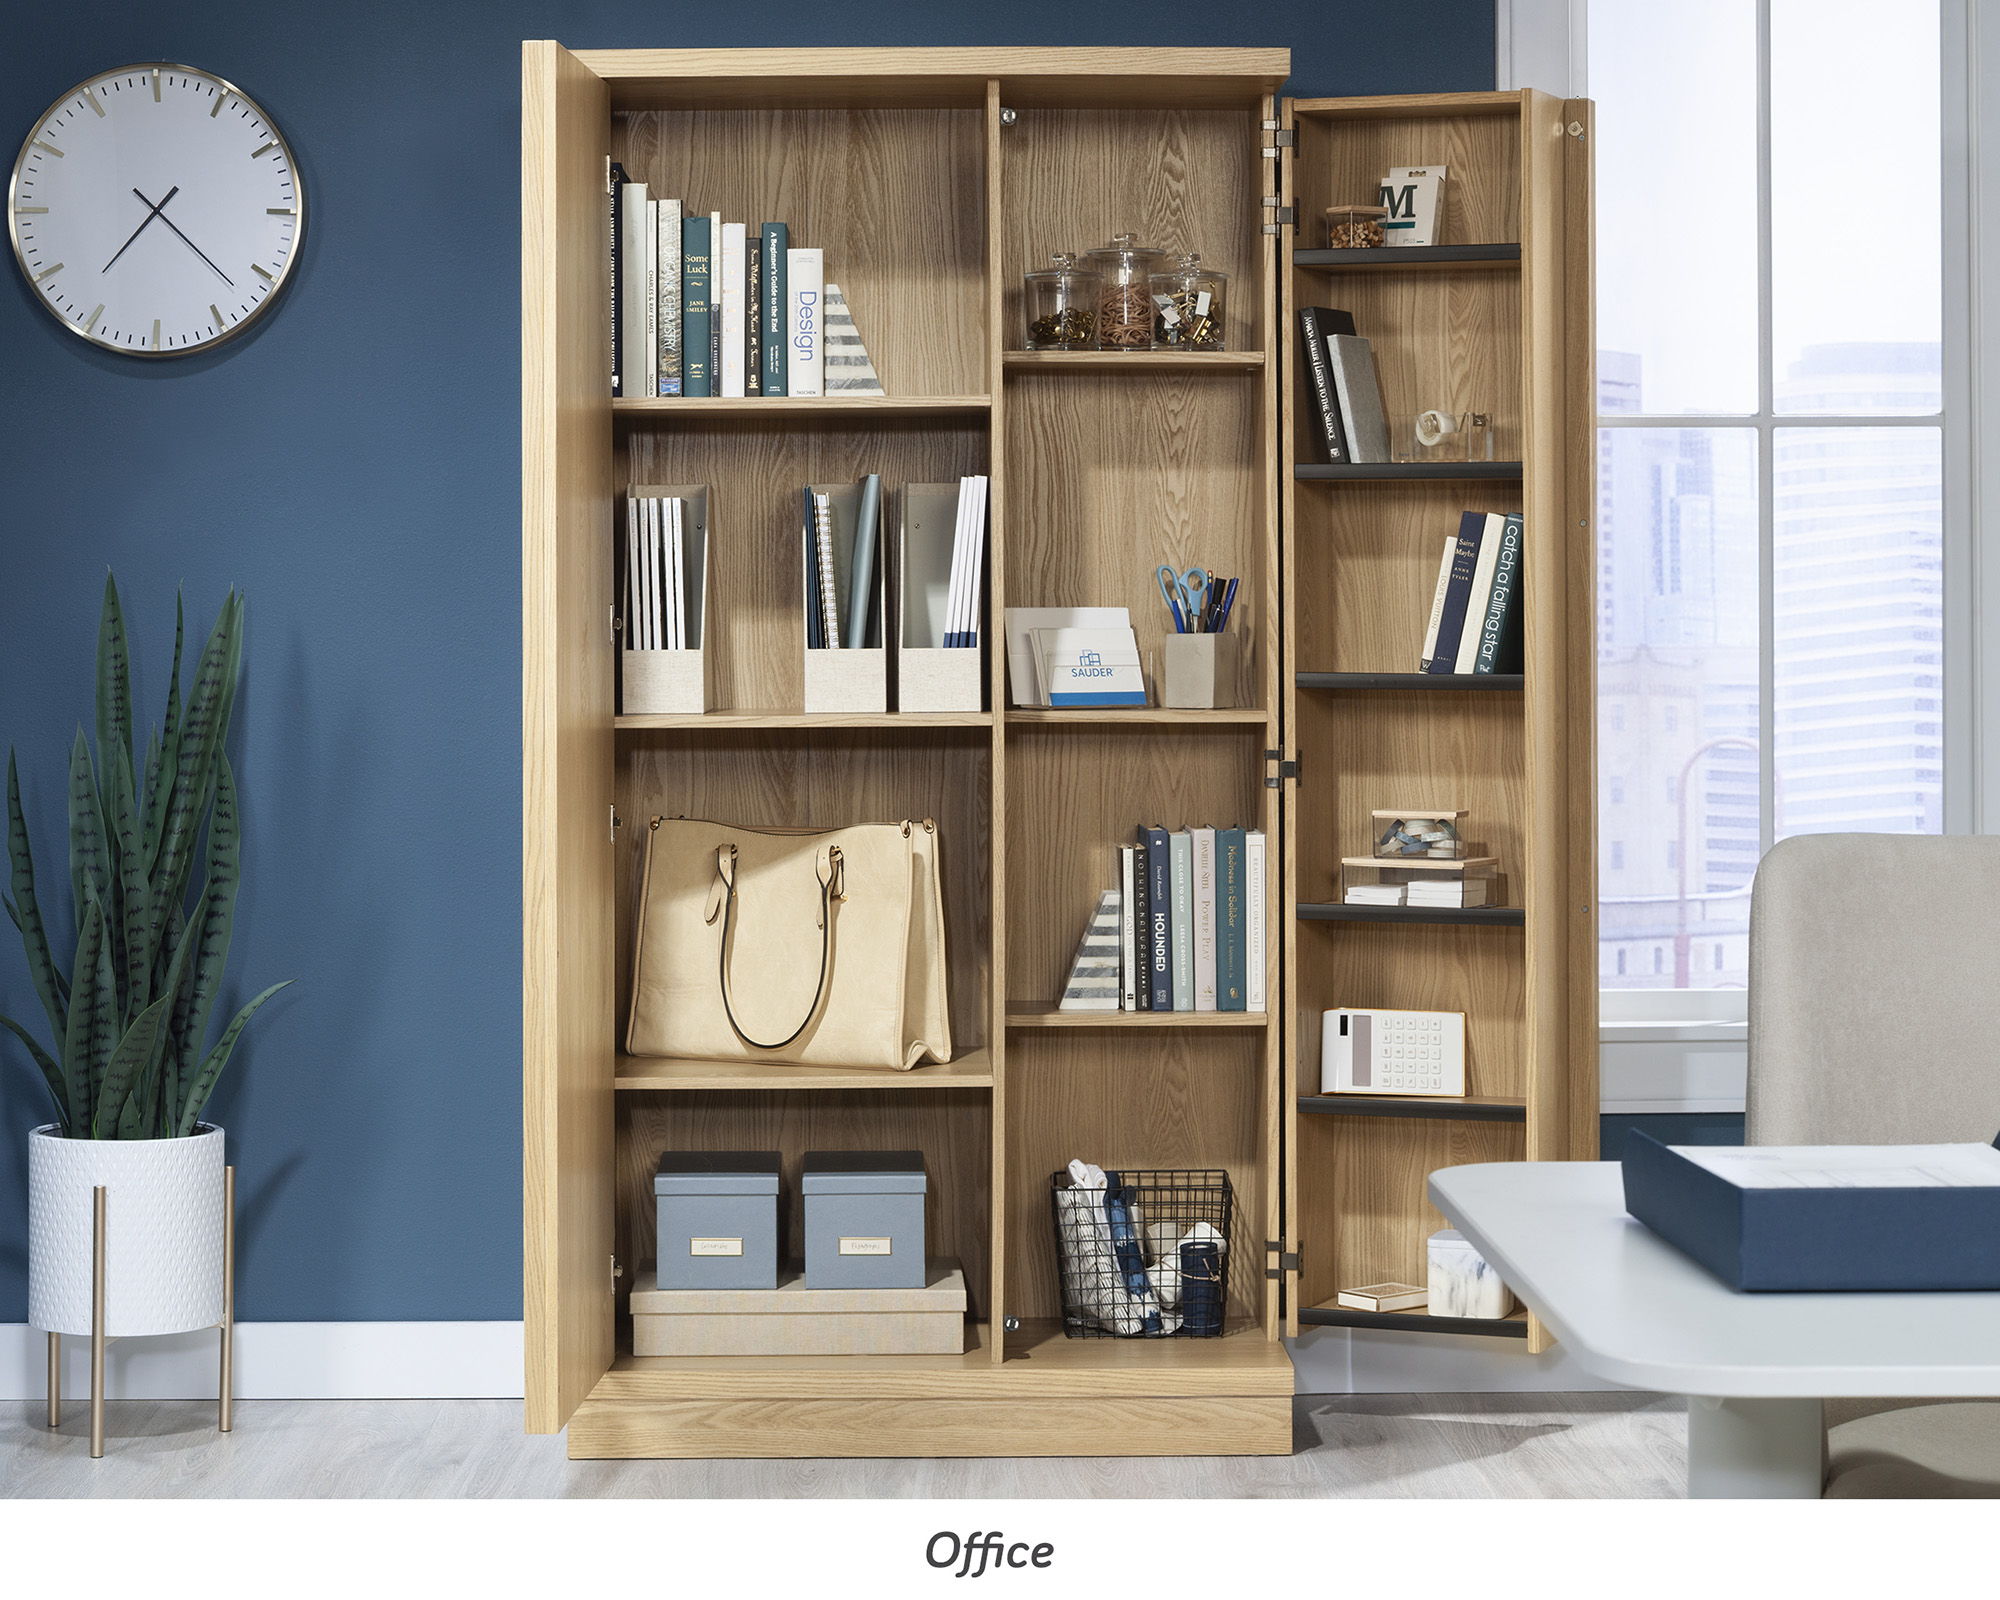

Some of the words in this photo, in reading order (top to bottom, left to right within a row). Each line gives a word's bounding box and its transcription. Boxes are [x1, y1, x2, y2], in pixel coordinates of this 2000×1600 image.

[685, 254, 709, 263] Some
[686, 263, 708, 274] Luck
[769, 238, 778, 275] Beginner's
[663, 246, 676, 293] ORGANIC
[770, 276, 778, 296] Guide
[770, 297, 777, 305] to
[771, 305, 779, 317] the
[663, 295, 676, 351] CHEMISTRY
[771, 318, 779, 333] End
[793, 291, 817, 361] Design
[1455, 548, 1475, 558] Maybe
[1458, 538, 1475, 548] Saint
[1499, 525, 1518, 571] catch
[1438, 576, 1447, 596] LOUIS
[1497, 572, 1509, 584] a
[1485, 586, 1510, 632] falling
[1481, 632, 1498, 661] star
[1071, 667, 1113, 678] SAUDER
[1200, 840, 1210, 869] DANIELLE
[1227, 845, 1239, 884] Madness
[1137, 854, 1145, 907] NOTHING
[1179, 885, 1184, 894] TO
[1228, 885, 1237, 894] in
[1201, 900, 1211, 934] POWER
[1228, 895, 1238, 928] Solidar
[1154, 912, 1166, 972] HOUNDED
[1202, 937, 1211, 961] PLAY
